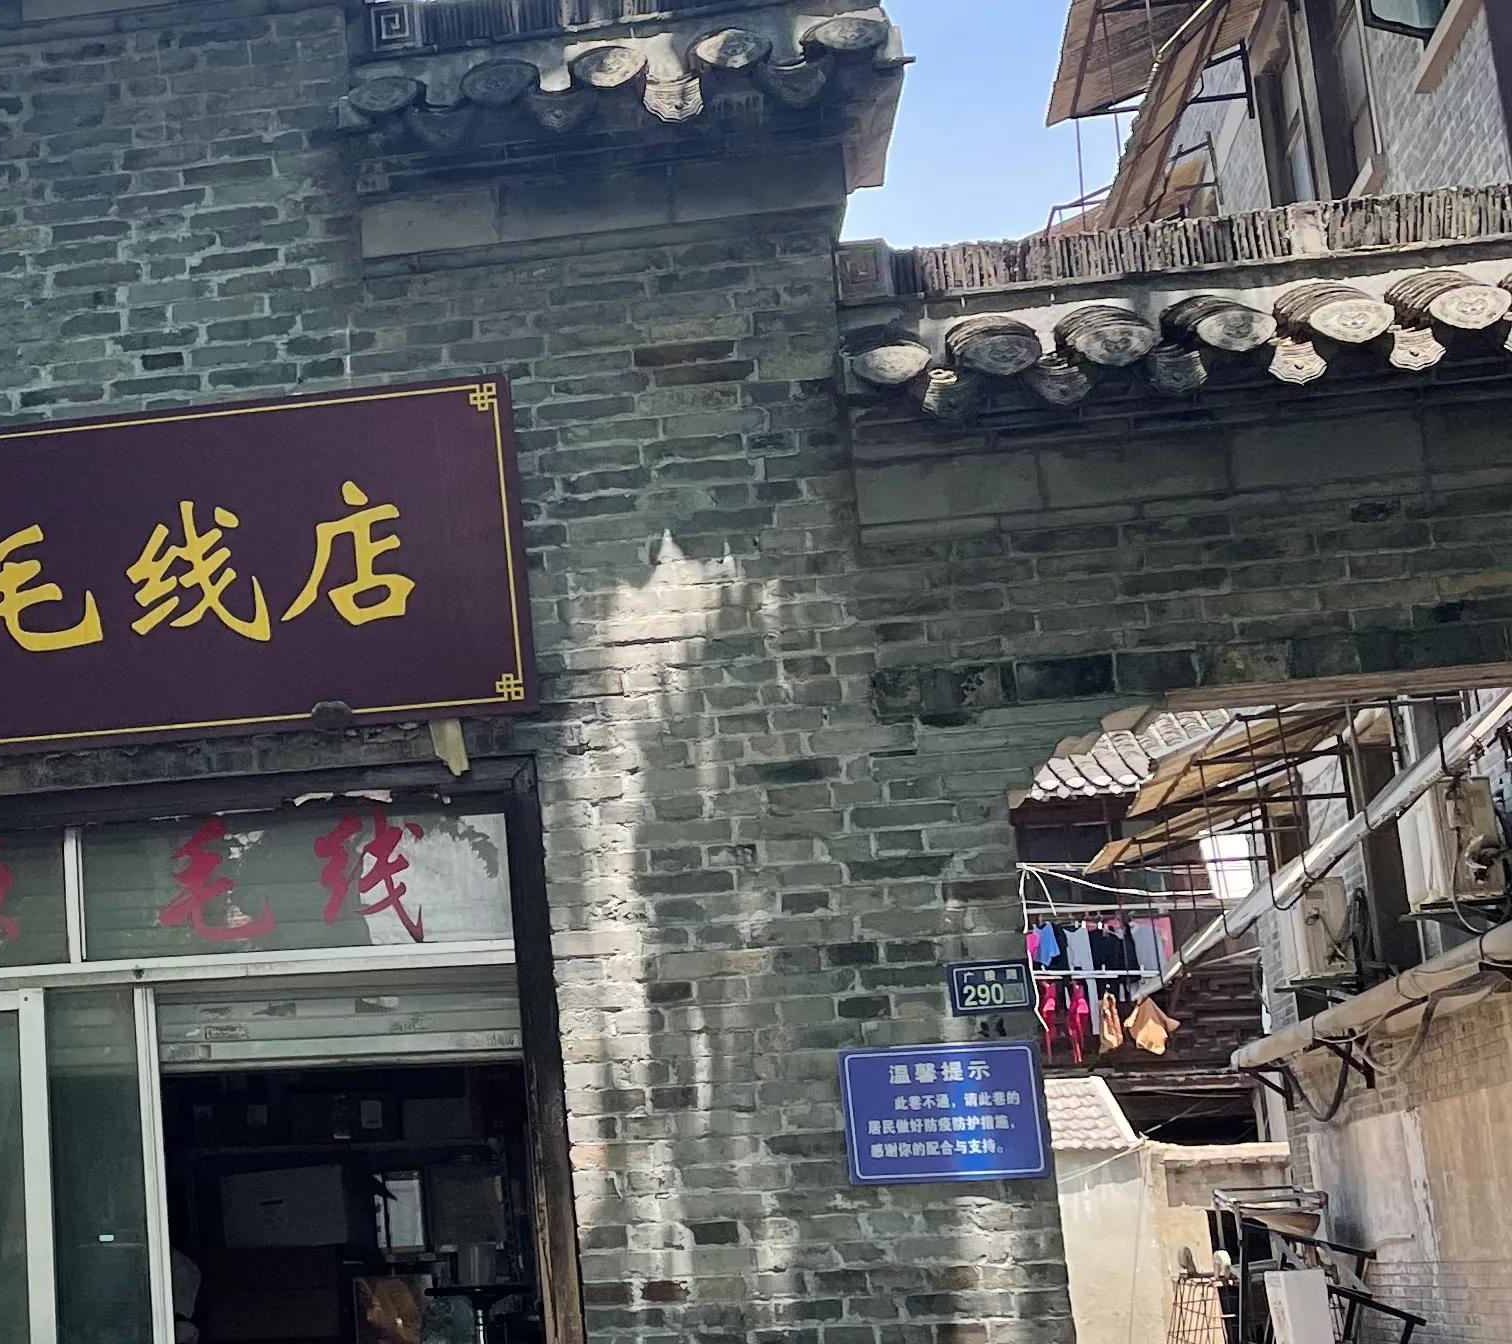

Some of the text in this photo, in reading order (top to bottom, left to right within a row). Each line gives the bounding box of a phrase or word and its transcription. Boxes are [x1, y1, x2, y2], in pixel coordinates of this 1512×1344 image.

[963, 983, 1005, 1007] 290
[888, 1060, 992, 1085] 温馨提示
